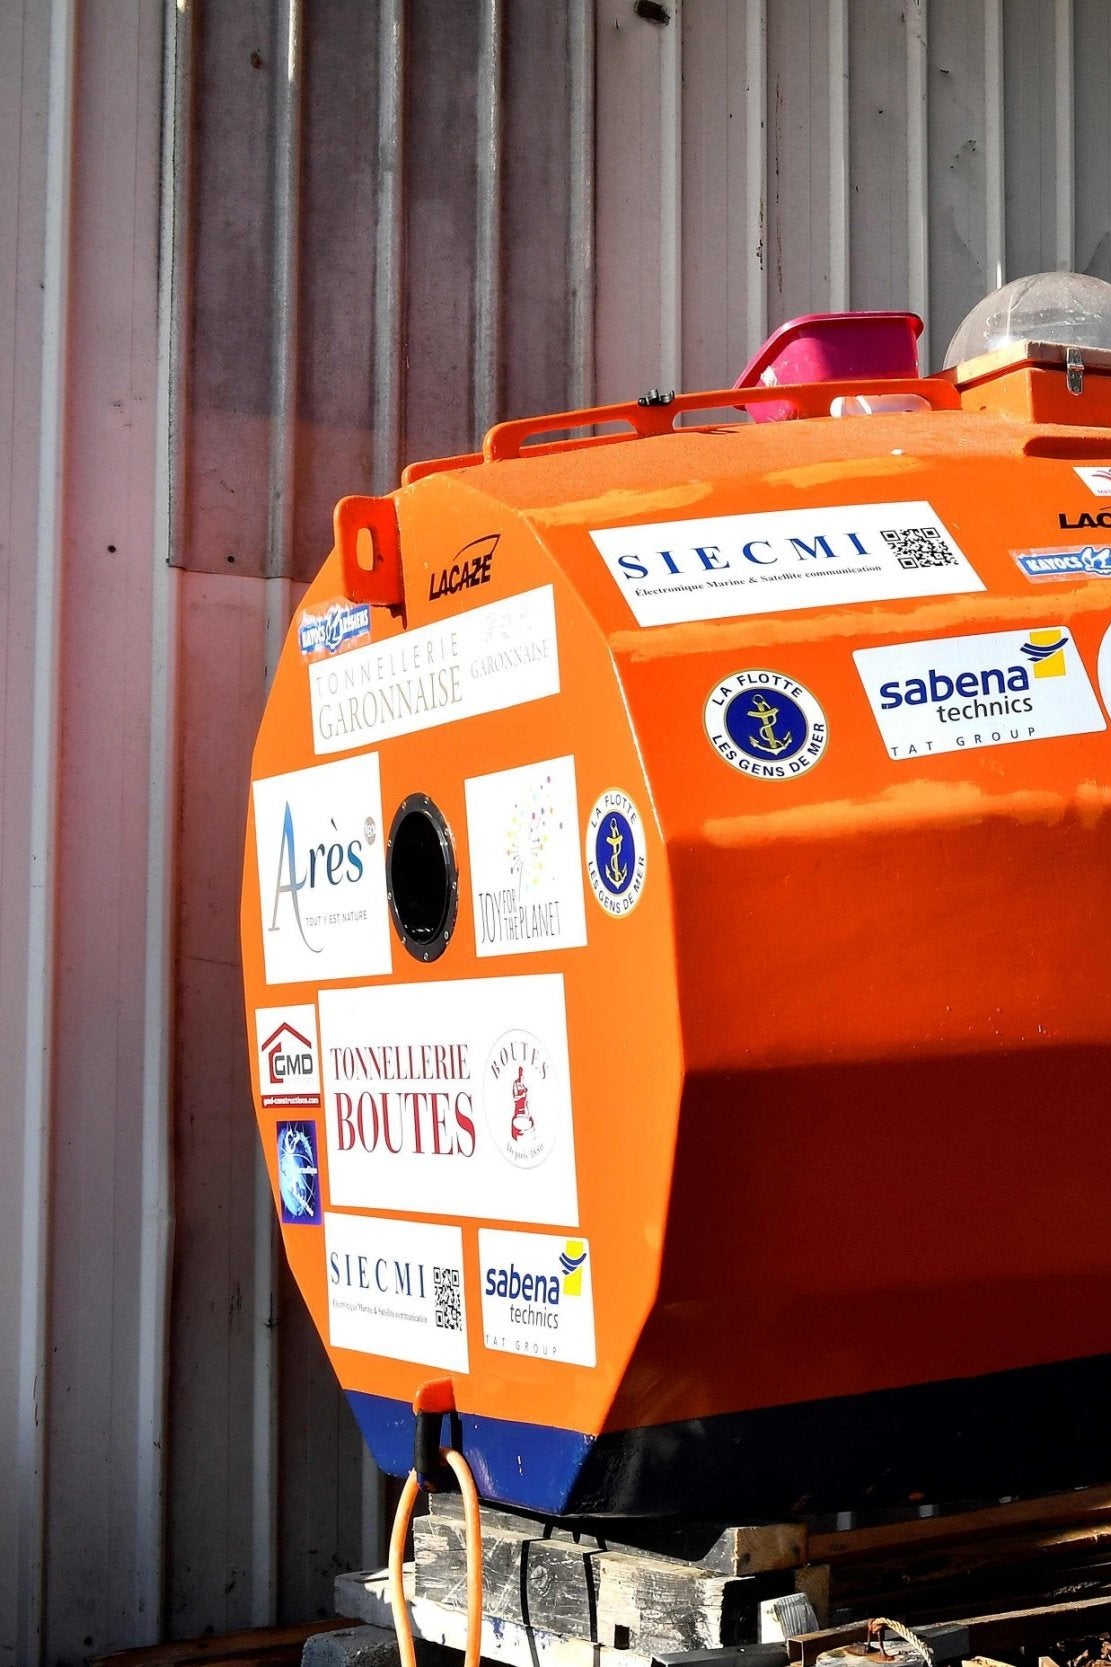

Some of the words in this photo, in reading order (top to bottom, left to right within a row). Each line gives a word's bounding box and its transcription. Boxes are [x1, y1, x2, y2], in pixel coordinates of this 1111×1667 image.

[428, 553, 492, 601] LACAZE
[617, 532, 872, 580] SIECMI
[635, 581, 704, 597] Électronique
[706, 579, 747, 589] Marine
[760, 571, 803, 582] Satellite
[804, 564, 882, 578] communication
[316, 632, 459, 697] TONNELLERIE
[469, 639, 550, 679] GARONNAISE
[318, 665, 463, 740] GARONNAISE
[711, 687, 732, 706] LA
[736, 673, 803, 698] FLOTTE
[879, 665, 1030, 710] sabena
[935, 696, 1033, 723] technics
[711, 734, 738, 761] LES
[738, 759, 786, 777] GENS
[788, 755, 811, 773] DE
[806, 722, 825, 756] MER
[891, 741, 934, 757] TAT
[955, 726, 1036, 747] GROUP
[590, 807, 602, 828] LA
[604, 794, 637, 825] FLOTTE
[268, 799, 364, 953] Arès
[588, 860, 600, 890] LES
[598, 889, 621, 914] GENS
[623, 893, 635, 911] DE
[633, 856, 645, 893] MER
[478, 890, 502, 944] JOY
[519, 900, 561, 940] PLANET
[274, 1053, 313, 1076] GMD
[329, 1043, 471, 1080] TONNELLERIE
[490, 1041, 549, 1080] BOUTES
[334, 1091, 477, 1158] BOUTES
[330, 1251, 426, 1298] SIECMI
[485, 1263, 560, 1305] sabena
[510, 1304, 559, 1330] technics
[485, 1334, 506, 1348] TAT
[515, 1340, 557, 1356] GROUP
